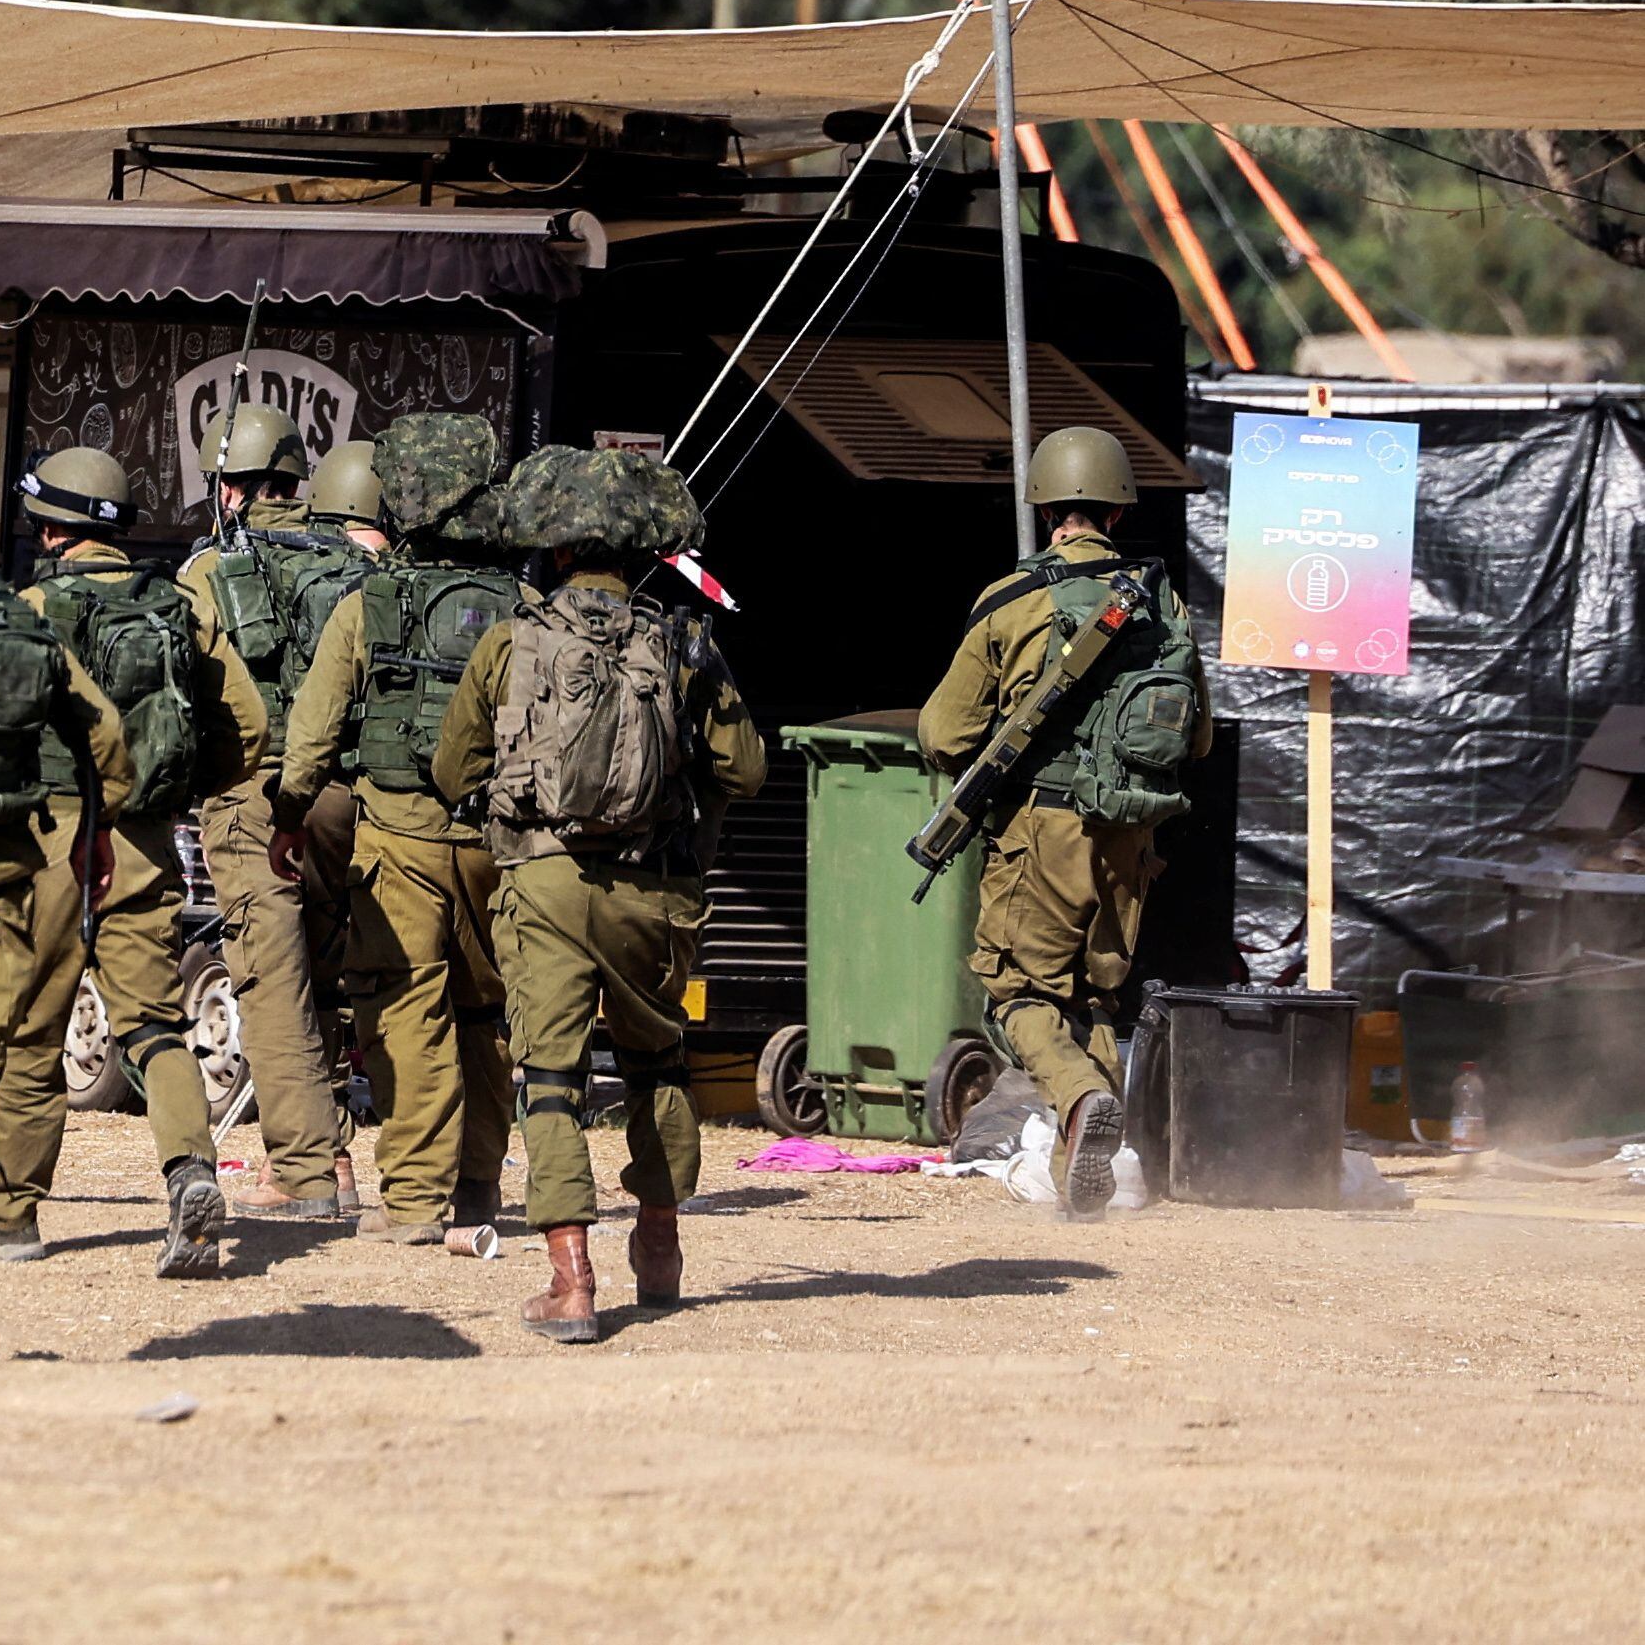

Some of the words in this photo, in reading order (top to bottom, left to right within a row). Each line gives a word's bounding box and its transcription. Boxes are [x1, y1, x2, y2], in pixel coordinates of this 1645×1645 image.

[1299, 434, 1352, 446] ECONOVA
[1300, 507, 1342, 527] רק
[1262, 527, 1379, 550] פלסטיק
